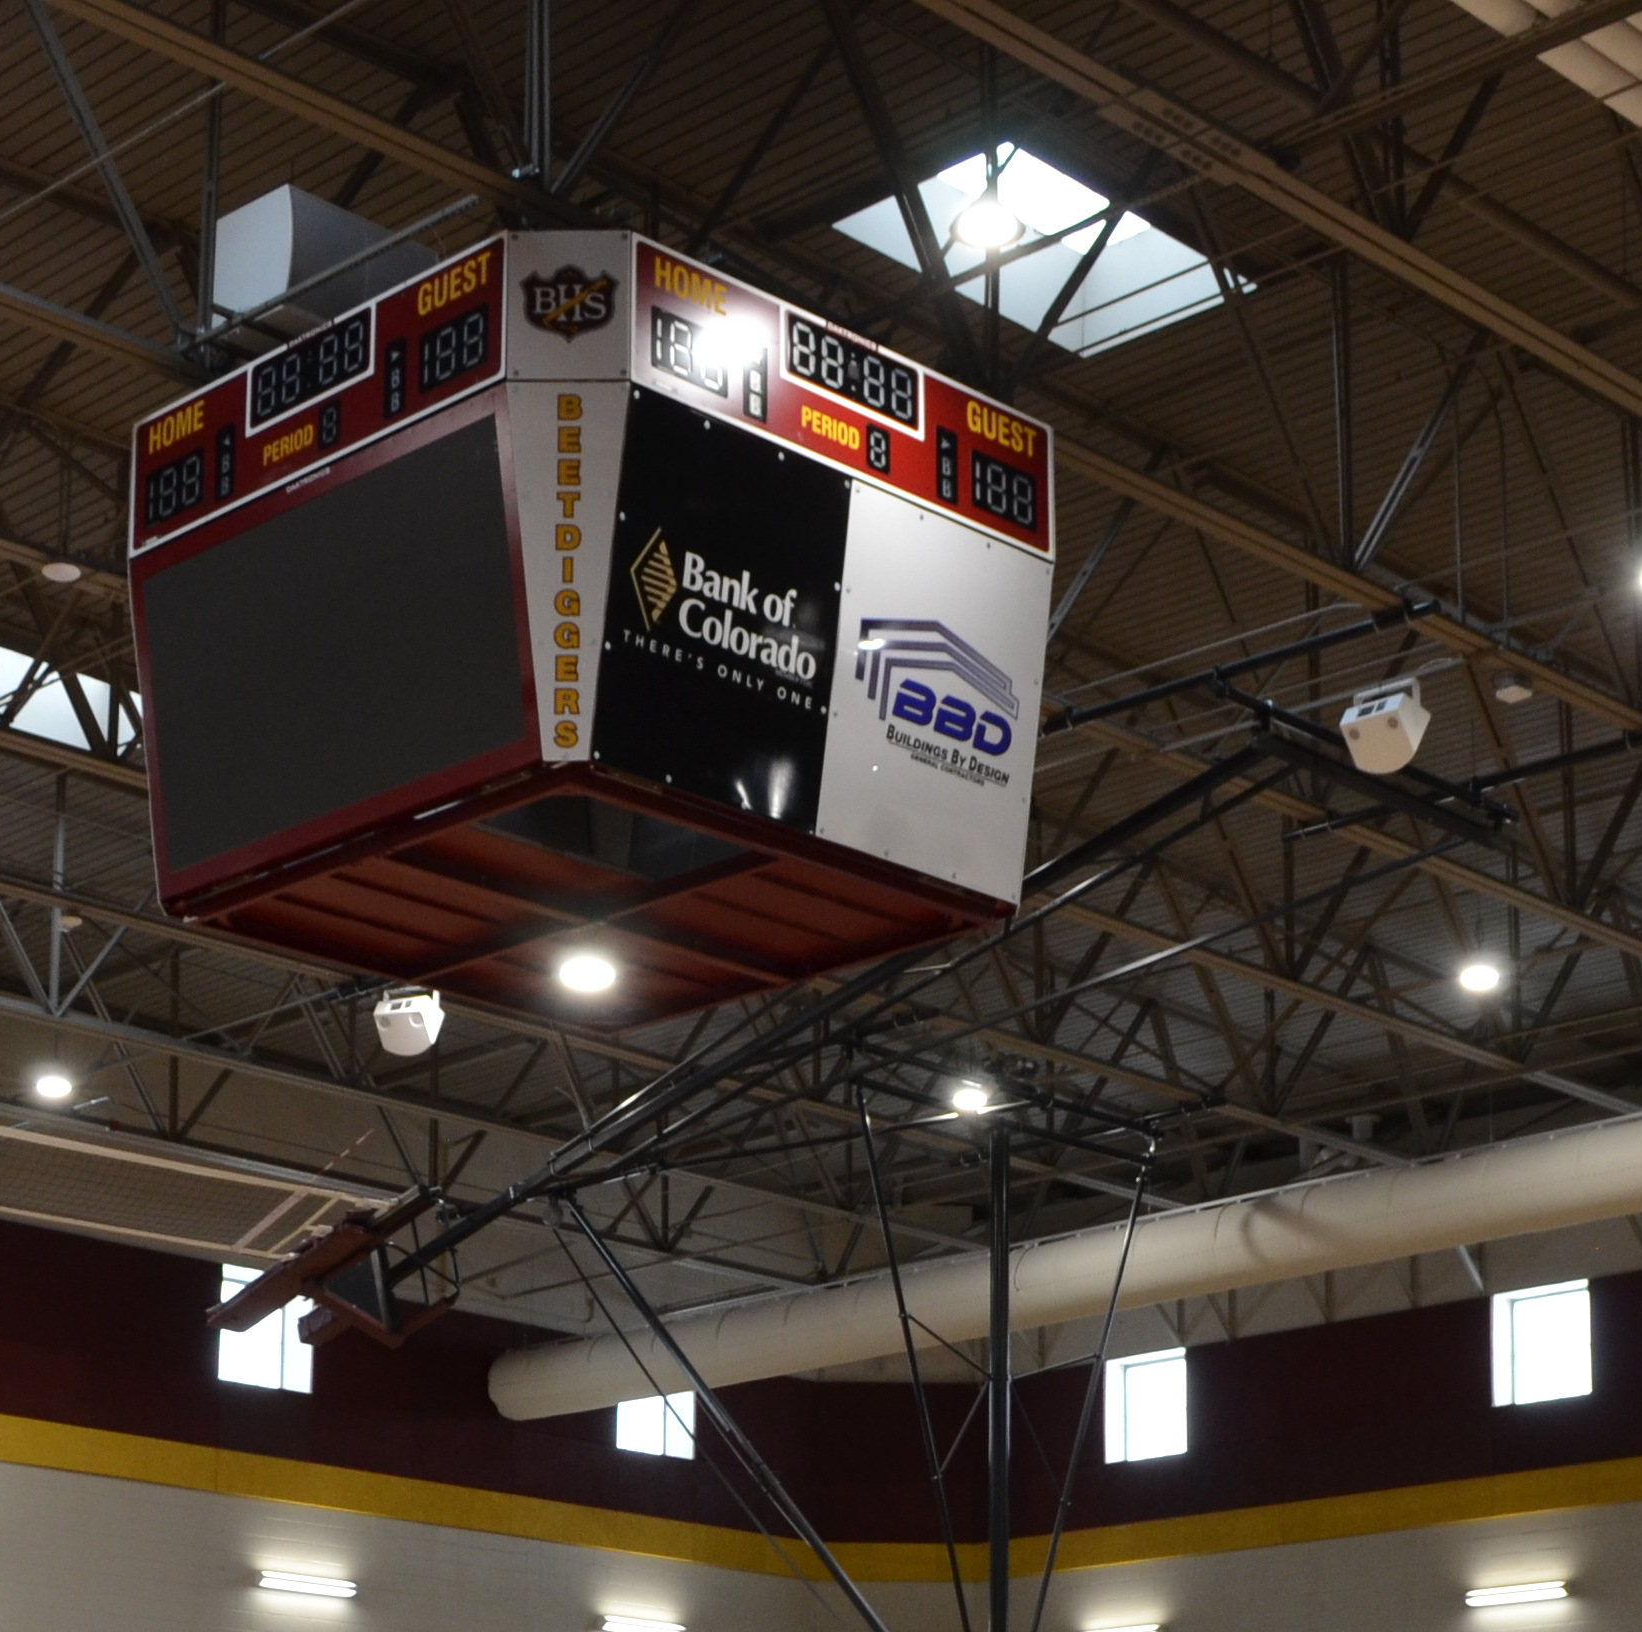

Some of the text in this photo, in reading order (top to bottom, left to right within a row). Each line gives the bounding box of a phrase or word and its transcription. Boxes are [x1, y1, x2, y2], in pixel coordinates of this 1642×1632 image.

[417, 251, 492, 317] GUEST
[532, 283, 607, 322] BHS
[655, 255, 728, 317] HOME
[147, 400, 205, 455] HOME
[262, 423, 314, 467] PERIOD
[801, 405, 861, 451] PERIOD
[966, 400, 1037, 458] GUEST
[553, 394, 584, 749] BEETDIGGERS
[682, 551, 798, 628] Bank of
[623, 629, 705, 671] THERE'S
[717, 664, 765, 691] ONLY
[776, 686, 813, 710] ONE
[678, 598, 817, 680] Colorado
[892, 678, 1013, 757] BBD
